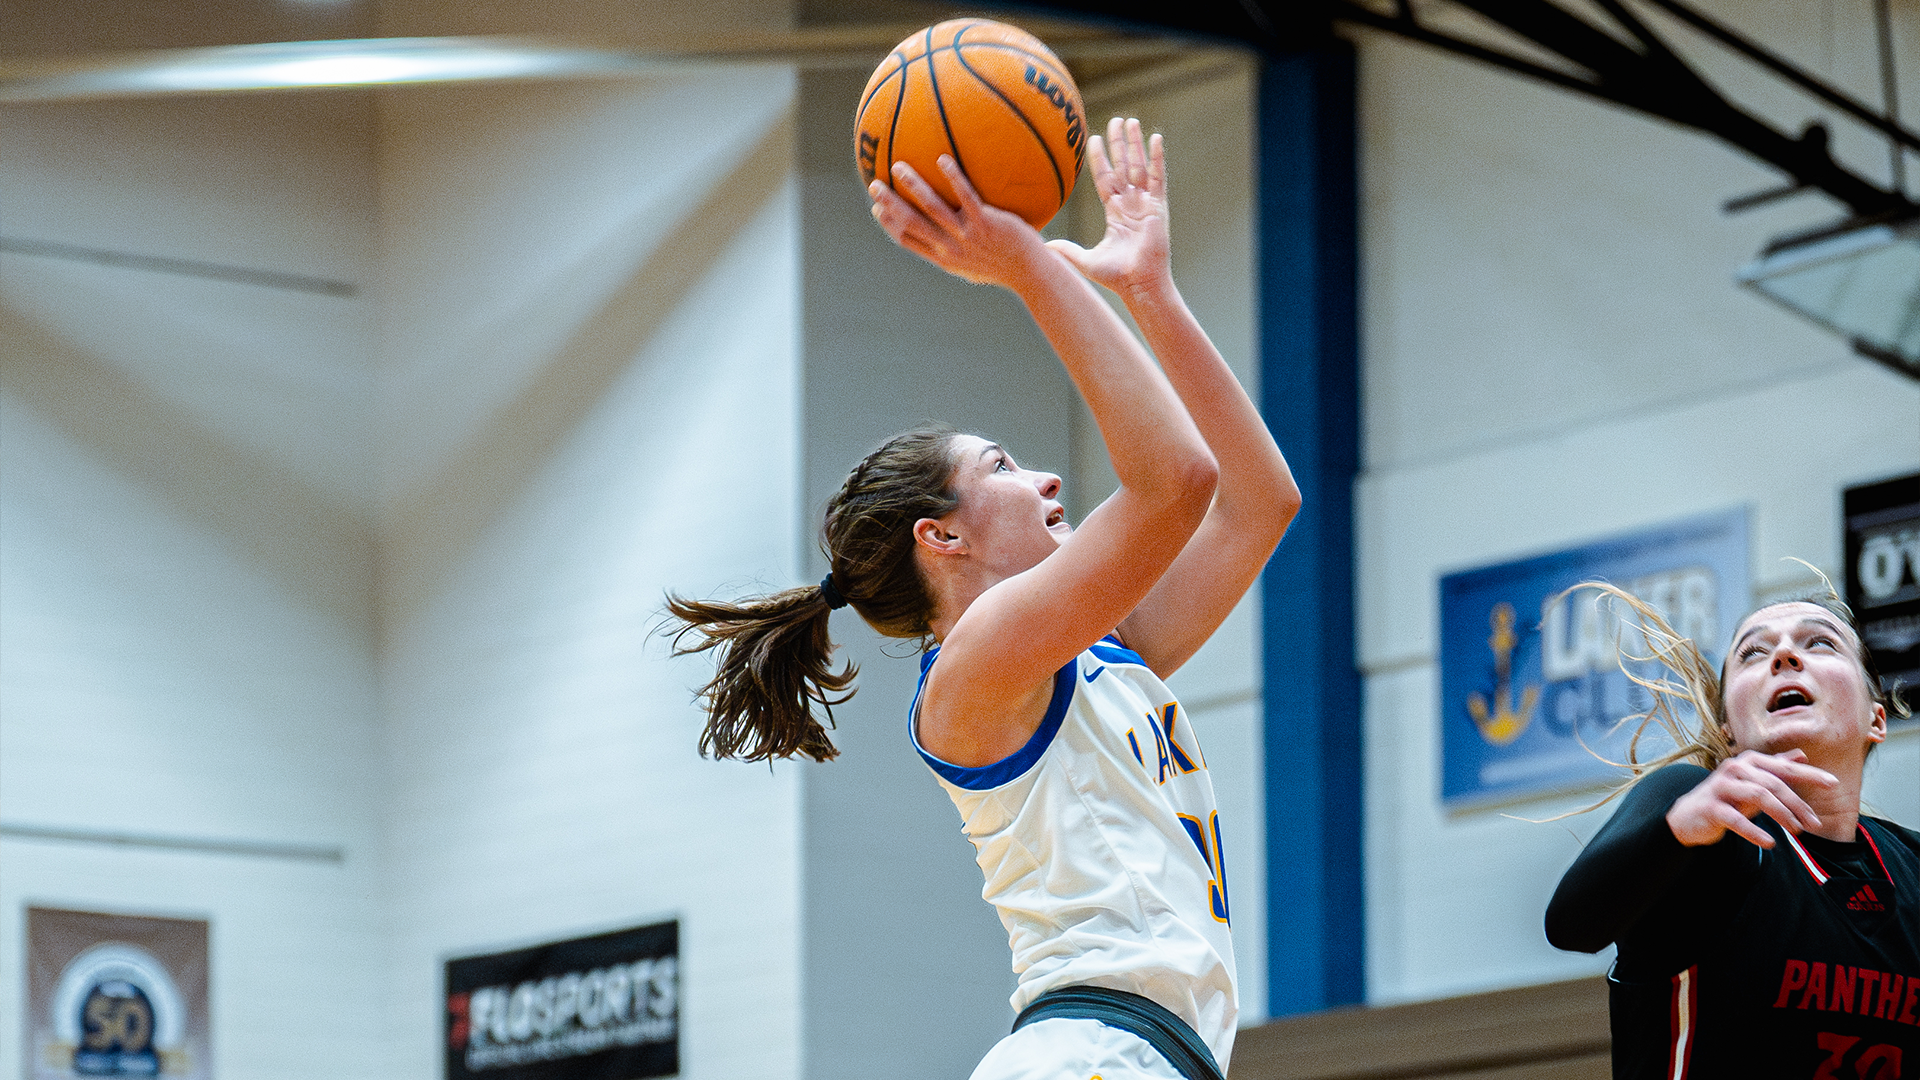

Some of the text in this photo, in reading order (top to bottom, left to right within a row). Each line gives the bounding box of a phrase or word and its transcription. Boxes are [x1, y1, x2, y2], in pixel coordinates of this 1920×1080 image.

[1541, 652, 1702, 739] CLU
[1125, 701, 1208, 786] LAK
[1773, 959, 1920, 1028] PANTHE
